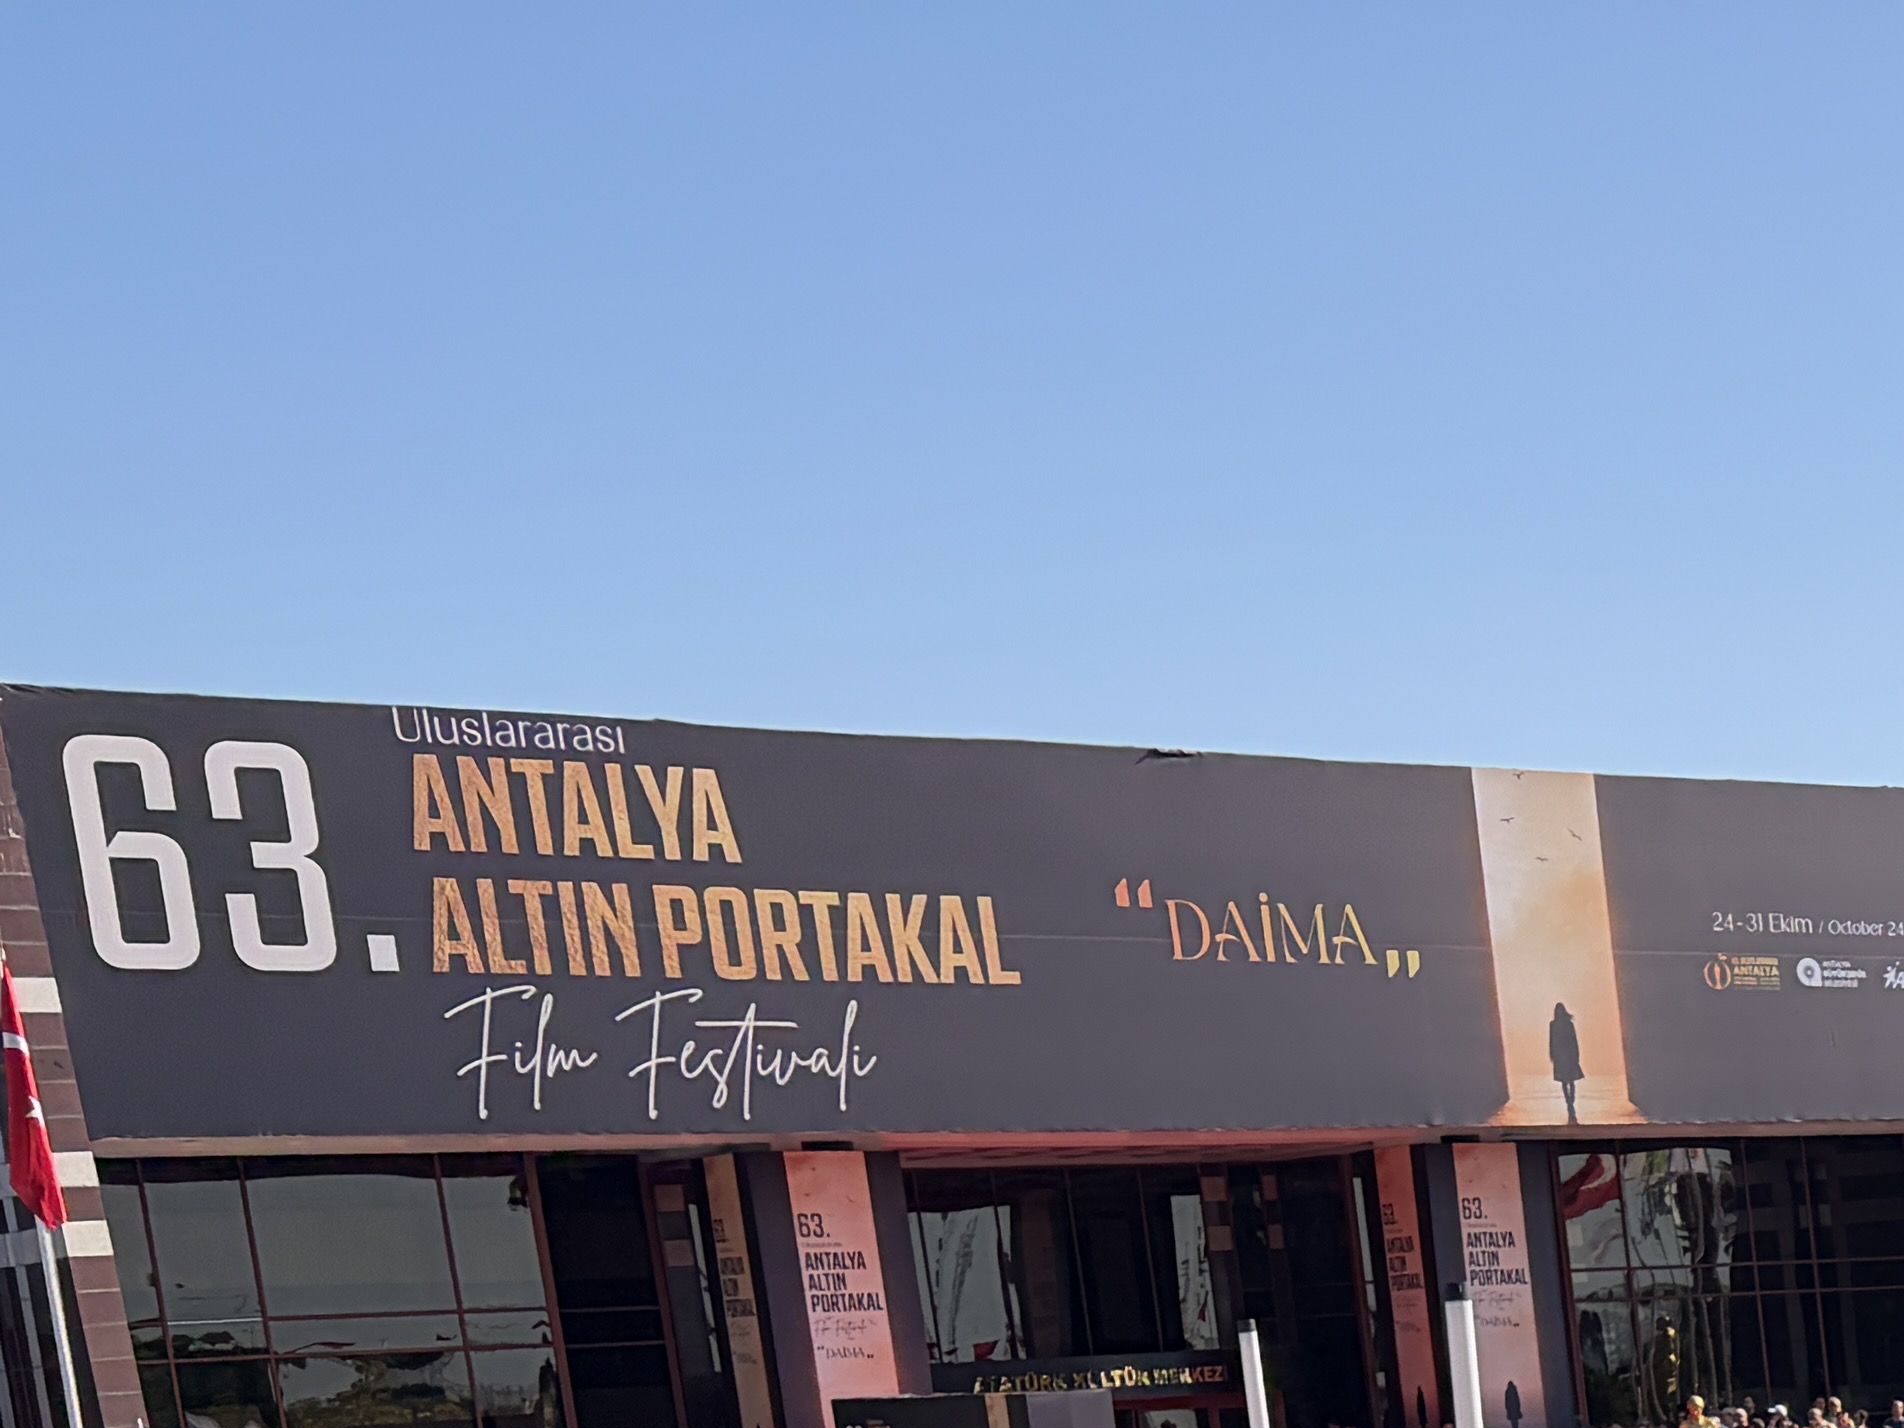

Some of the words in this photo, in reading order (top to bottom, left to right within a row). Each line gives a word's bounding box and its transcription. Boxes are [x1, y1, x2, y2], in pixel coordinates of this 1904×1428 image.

[391, 705, 626, 754] Uluslararası
[411, 753, 743, 864] ANTALYA
[62, 734, 401, 973] 63.
[430, 876, 643, 979] ALTIN
[652, 884, 1022, 987] PORTAKAL
[1711, 911, 1763, 934] 24-31
[1768, 912, 1814, 935] Ekim
[1828, 919, 1883, 937] October
[442, 985, 598, 1120] Film
[614, 988, 878, 1121] Festivali
[1461, 1197, 1488, 1219] 63.
[797, 1213, 831, 1238] 63.
[1466, 1231, 1516, 1249] ANTALYA
[805, 1250, 867, 1271] ANTALYA
[1468, 1250, 1500, 1268] ALTIN
[808, 1272, 848, 1293] ALTIN
[1470, 1268, 1529, 1287] PORTAKAL
[810, 1292, 884, 1313] PORTAKAL
